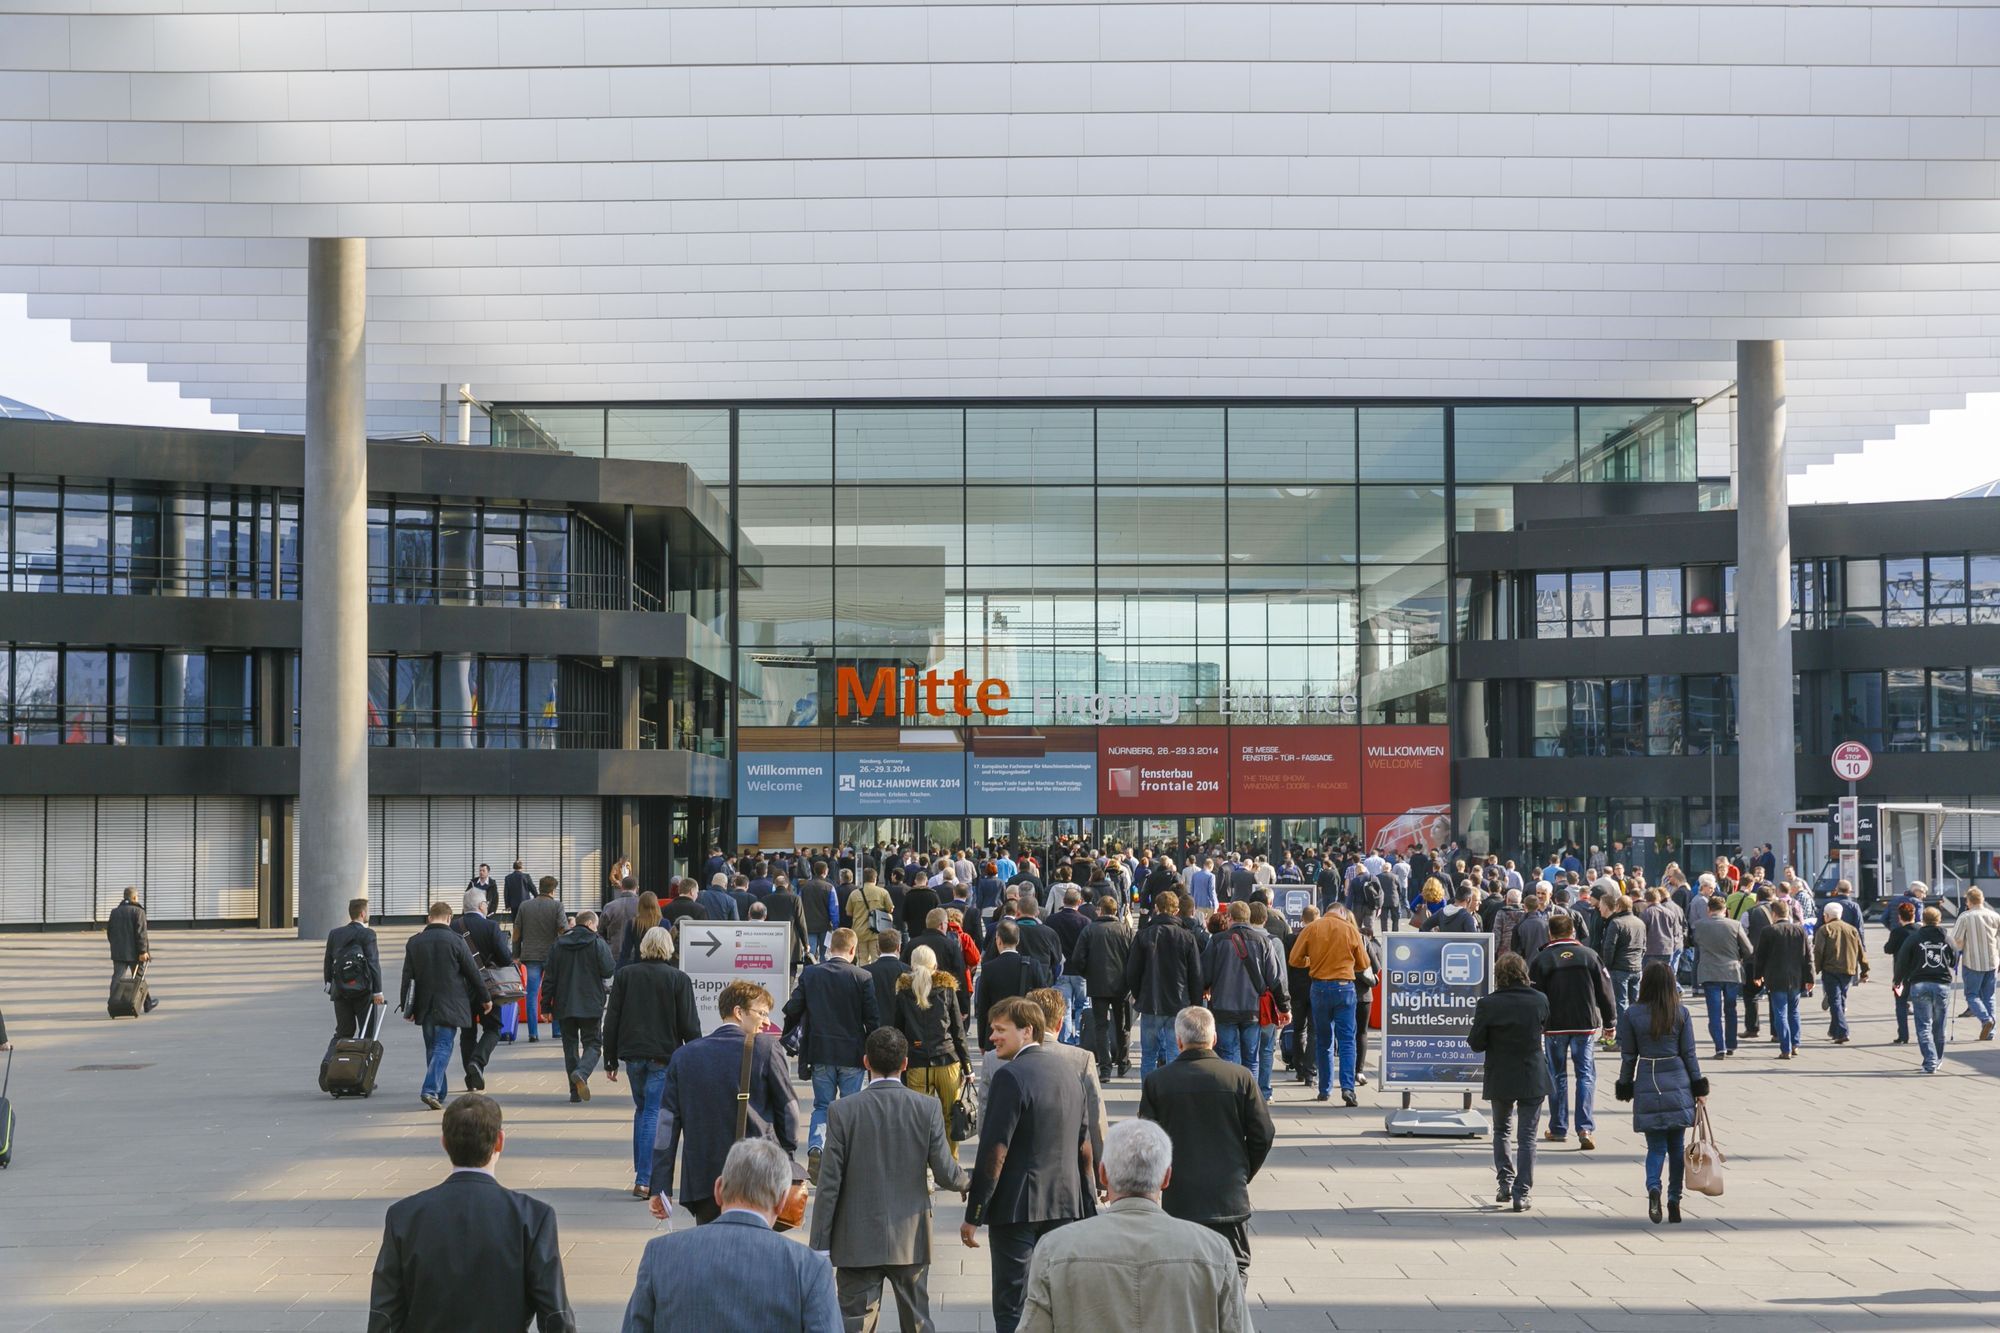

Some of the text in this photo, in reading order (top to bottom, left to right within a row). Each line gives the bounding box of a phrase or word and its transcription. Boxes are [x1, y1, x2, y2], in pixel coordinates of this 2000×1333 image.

[837, 666, 1011, 717] Mitte
[1033, 686, 1179, 725] Eingang
[1219, 685, 1358, 715] Entrance
[1108, 746, 1155, 755] NÜRNBERG,
[1367, 746, 1444, 756] WILLKOMMEN
[1280, 753, 1295, 761] TÜR
[1367, 759, 1423, 769] WELCOME
[1846, 763, 1860, 775] 10
[747, 764, 823, 776] Willkommen
[1141, 768, 1193, 779] fensterbau
[747, 780, 804, 792] Welcome
[859, 779, 960, 789] HOLZ-HANDWERK 2014
[1140, 780, 1219, 791] frontale 2014
[700, 994, 712, 1002] die
[1391, 1013, 1475, 1026] ShuttleServic
[1391, 1039, 1402, 1047] ab
[1437, 1040, 1456, 1048] 0:30
[1458, 1040, 1470, 1048] Uh
[1391, 1050, 1409, 1058] from
[1441, 1051, 1459, 1059] 0:30
